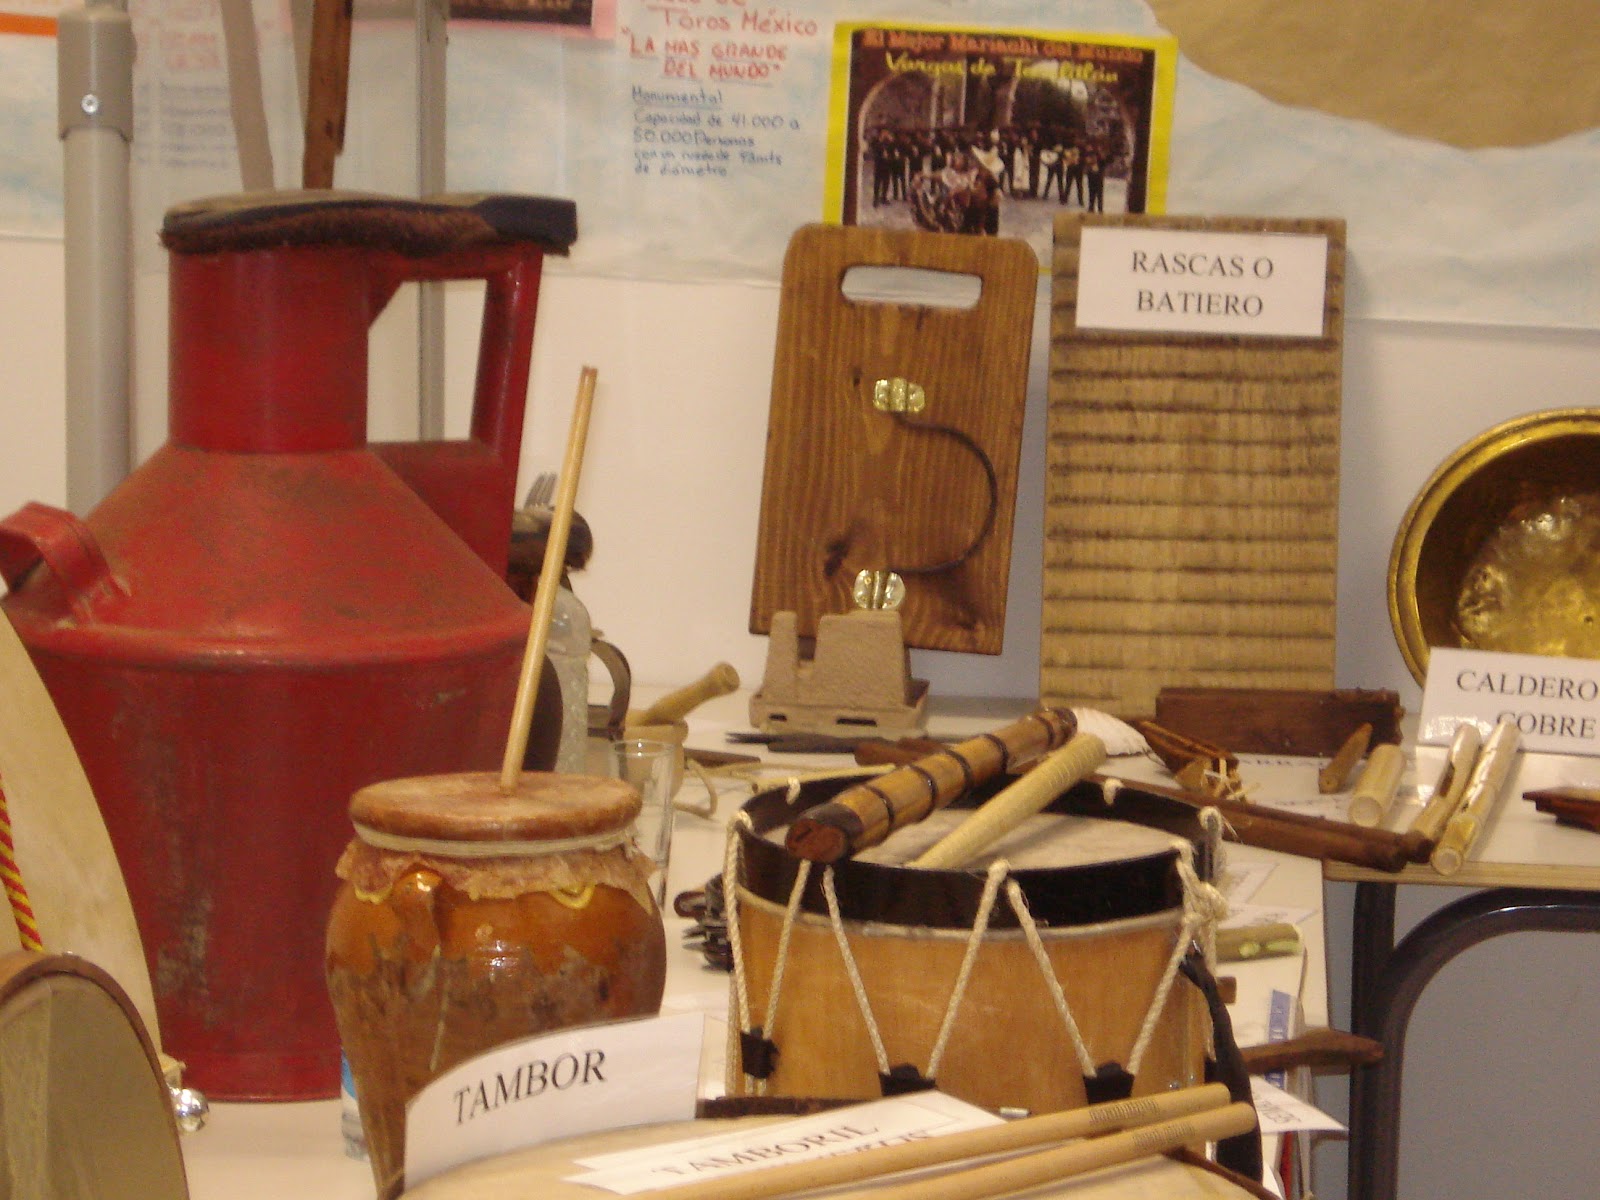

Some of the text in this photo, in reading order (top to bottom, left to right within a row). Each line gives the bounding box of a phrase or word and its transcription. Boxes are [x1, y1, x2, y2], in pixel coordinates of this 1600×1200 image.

[663, 8, 731, 31] Toros
[711, 41, 788, 61] GRANDE
[664, 56, 698, 79] DEL
[1131, 250, 1274, 280] RASCAS O
[1136, 289, 1264, 318] BATIERO
[1456, 669, 1599, 701] CALDERO
[1496, 710, 1597, 740] COBRE
[453, 1049, 608, 1126] TAMBOR
[651, 1124, 880, 1176] TAMBORIL
